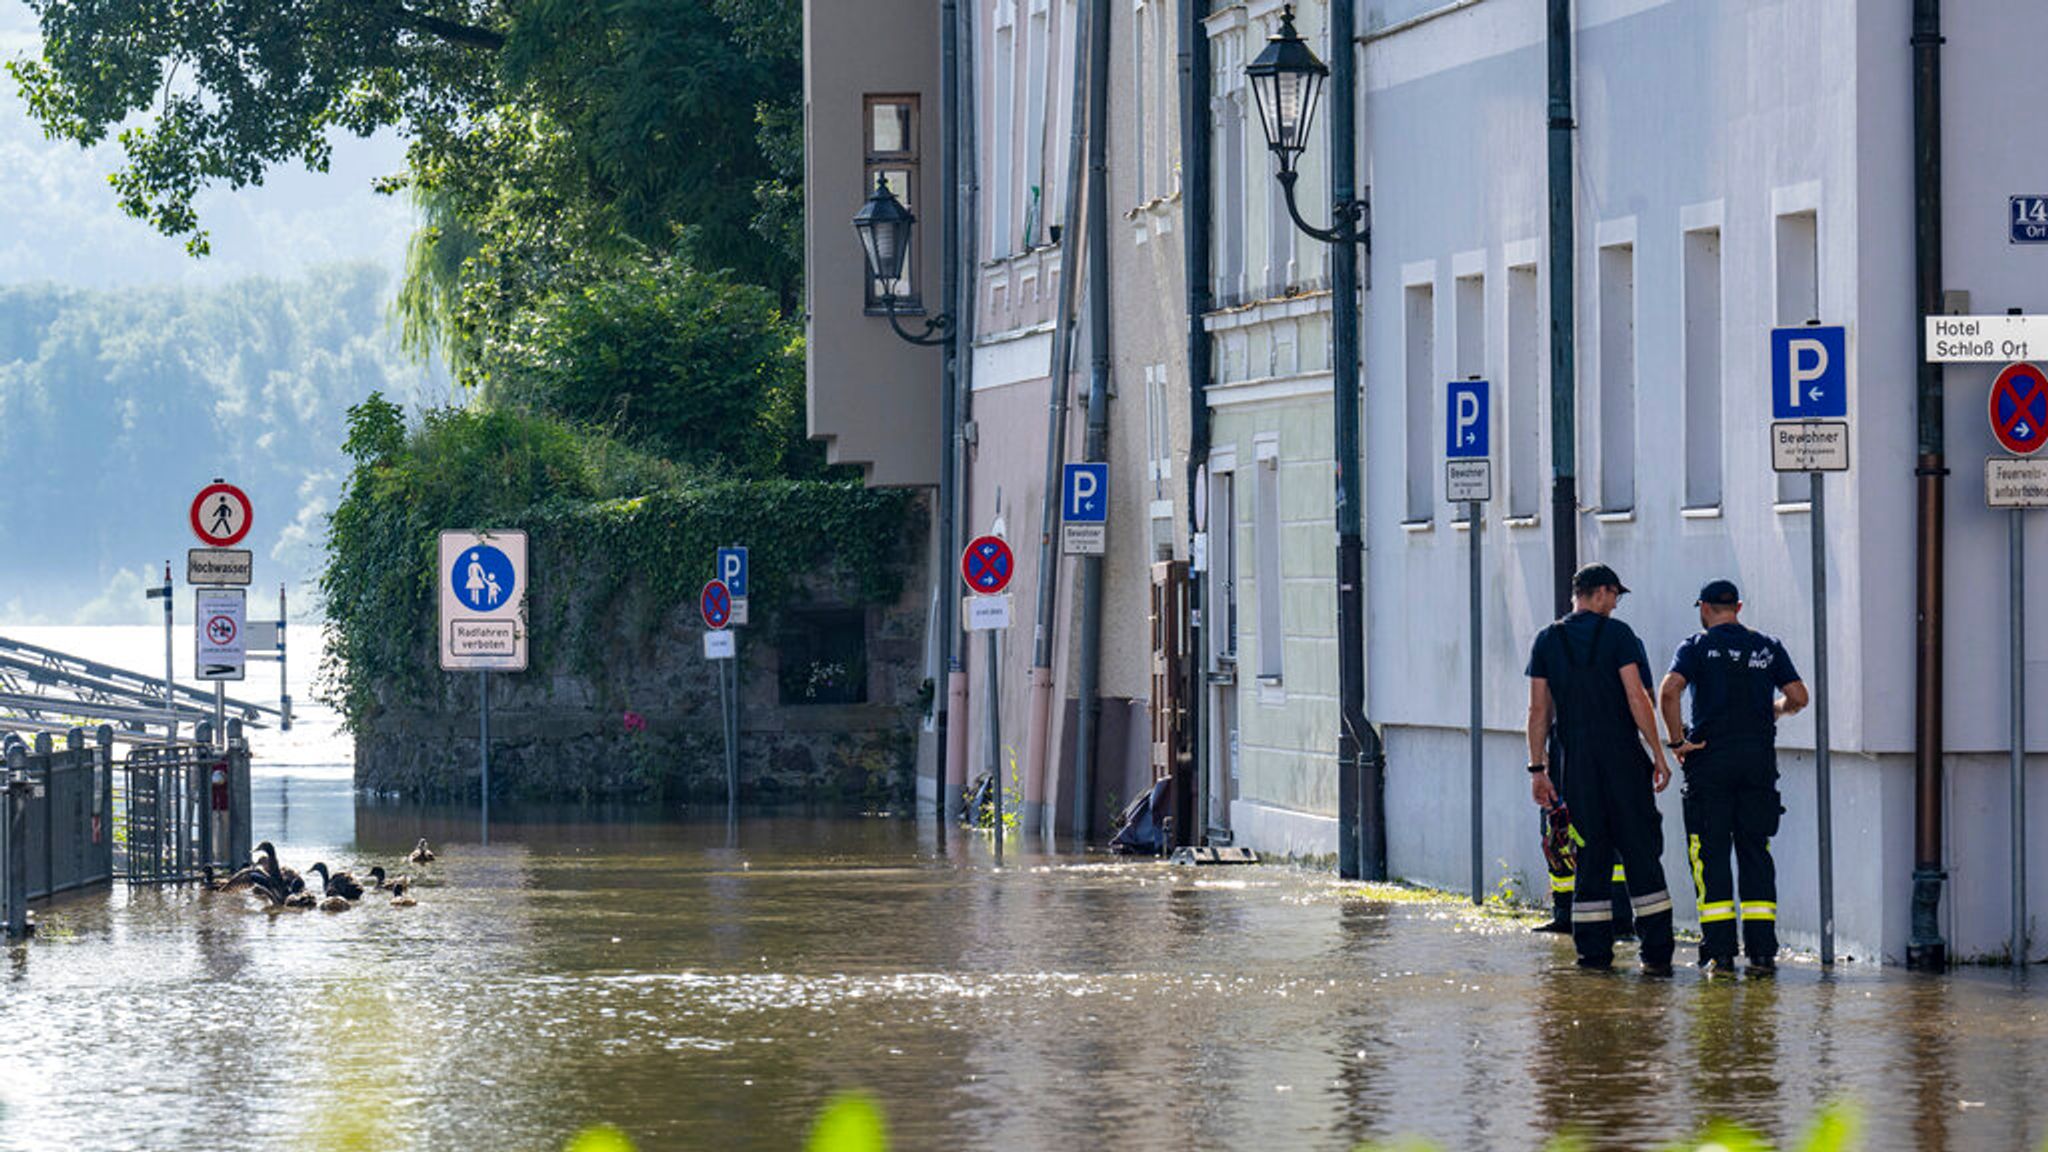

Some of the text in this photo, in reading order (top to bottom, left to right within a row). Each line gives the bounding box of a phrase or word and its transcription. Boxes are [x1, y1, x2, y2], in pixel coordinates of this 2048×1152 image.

[2016, 199, 2048, 221] 14
[1935, 320, 1980, 336] Hotel
[1936, 340, 2028, 357] Schloß Ort
[1789, 338, 1829, 407] P
[1456, 391, 1479, 447] P
[1779, 430, 1839, 444] Bewohner
[1073, 470, 1098, 514] P
[190, 560, 249, 575] Hochwasser
[725, 554, 741, 589] P
[457, 627, 509, 638] Radfahren
[462, 640, 505, 650] verboten
